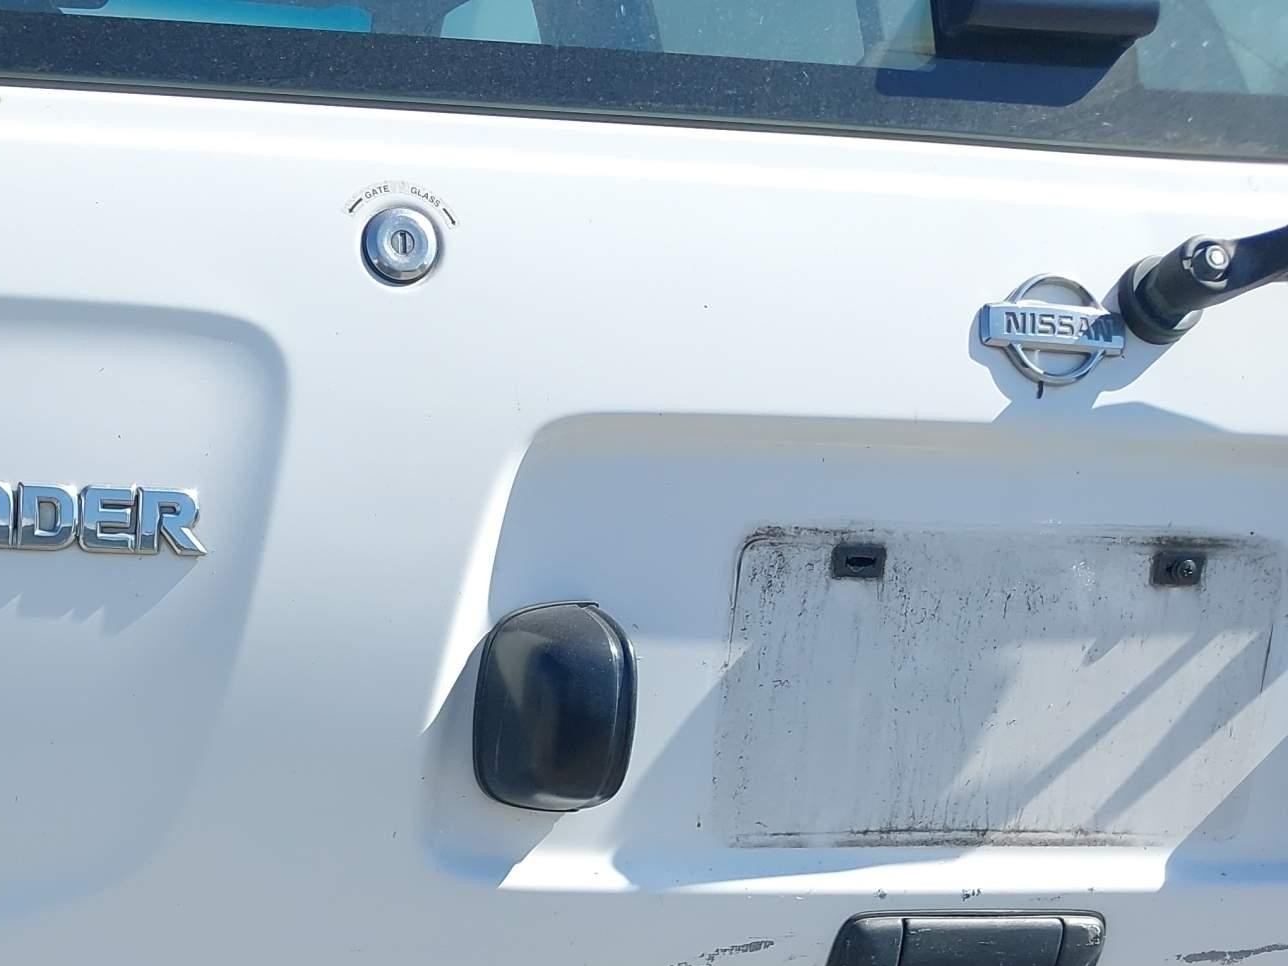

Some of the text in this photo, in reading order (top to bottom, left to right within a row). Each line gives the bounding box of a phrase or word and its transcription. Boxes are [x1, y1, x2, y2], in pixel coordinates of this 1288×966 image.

[364, 184, 390, 200] GATE
[410, 185, 441, 208] GLASS
[1002, 310, 1113, 343] NISSAN
